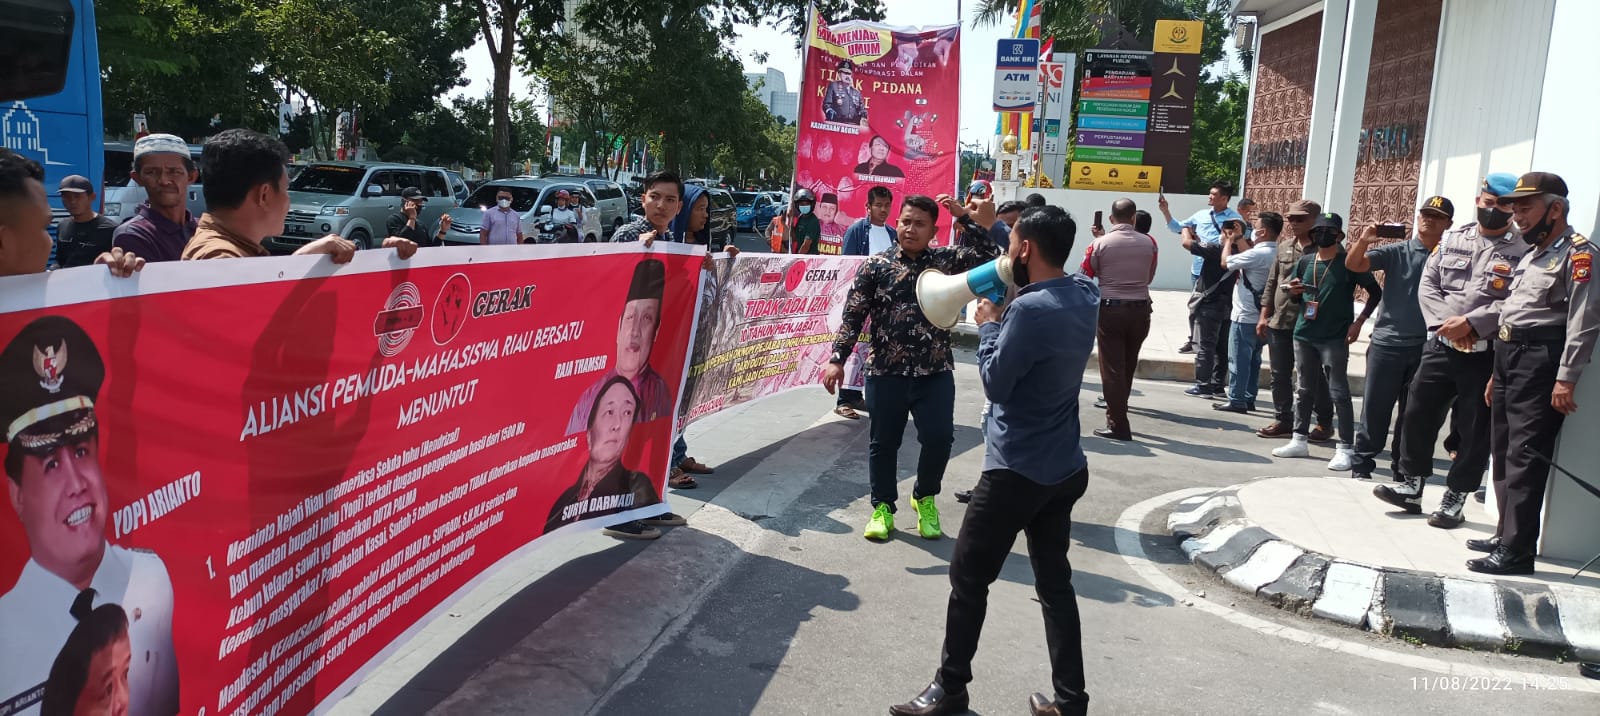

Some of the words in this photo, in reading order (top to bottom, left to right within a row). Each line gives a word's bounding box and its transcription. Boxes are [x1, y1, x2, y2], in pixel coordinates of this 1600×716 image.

[848, 42, 880, 56] UMUM
[873, 80, 922, 95] PIDANA
[1003, 73, 1030, 82] ATM
[805, 269, 840, 282] GERAK
[471, 285, 536, 319] GERAK
[744, 297, 784, 319] TIDAK
[782, 297, 807, 315] ADA
[807, 295, 829, 313] IZIN
[748, 324, 775, 341] TAHUN
[774, 319, 818, 337] MENJABAT
[239, 382, 328, 442] ALIANSI
[331, 340, 499, 409] PEMUDA-MAHASISWA
[501, 334, 531, 358] RIAU
[533, 319, 585, 349] BERSATU
[554, 361, 574, 380] RAJA
[573, 354, 608, 376] THAMSIR
[396, 378, 480, 431] MENUNTUT
[113, 498, 148, 540] YOPI
[149, 470, 201, 523] ARIANTO
[226, 521, 276, 567] Meminta
[276, 501, 305, 538] Kejati
[303, 490, 325, 519] Riau
[324, 466, 376, 505] memeriksa
[375, 455, 402, 480] Sekda
[401, 446, 422, 470] Inhu
[228, 570, 249, 600] Dan
[248, 543, 287, 585] mantan
[287, 519, 319, 558] bupati
[319, 508, 340, 537] Inhu
[340, 494, 364, 524] (Yopi)
[364, 476, 393, 507] terkait
[392, 466, 422, 494] dugaan
[421, 449, 469, 482] penggelapan
[469, 436, 487, 456] hasil
[486, 429, 500, 448] dari
[500, 423, 517, 443] 1500
[561, 500, 589, 522] SURYA
[588, 492, 636, 513] DARMADI
[205, 554, 216, 581] 1.
[218, 617, 267, 661] Kepada
[266, 575, 321, 630] masyarakat
[320, 543, 364, 588] Pangkalan
[388, 511, 412, 539] Sudah
[411, 508, 418, 525] 5
[418, 498, 438, 523] tahun
[438, 482, 469, 509] hasilnya
[468, 474, 488, 493] TIDAK
[487, 459, 518, 482] diberikan
[518, 449, 541, 469] kepada
[225, 591, 263, 630] Kebun
[262, 571, 295, 605] kelapa
[294, 549, 321, 578] sawit
[320, 543, 332, 564] yg
[331, 518, 372, 553] diberikan
[371, 503, 393, 527] DUTA
[392, 487, 417, 516] PALMA
[217, 649, 270, 713] Mendesak
[269, 614, 325, 665] KEJAKSAAN
[323, 588, 352, 625] AGUNG
[350, 565, 380, 604] melalui
[379, 549, 404, 580] KAJATI
[403, 540, 423, 565] RIAU
[485, 492, 505, 513] serius
[505, 486, 518, 502] dan
[273, 650, 302, 688] dalam
[302, 599, 367, 662] menyelesaikan
[366, 578, 396, 611] dugaan
[395, 548, 441, 588] keterlibatan
[440, 532, 465, 556] banyak
[464, 517, 490, 544] pejabat
[280, 654, 326, 709] persoalan
[325, 636, 348, 666] suap
[347, 622, 367, 648] duta
[366, 601, 392, 634] palma
[391, 581, 420, 614] dengan
[419, 564, 440, 592] lahan
[439, 544, 476, 582] bodongnya
